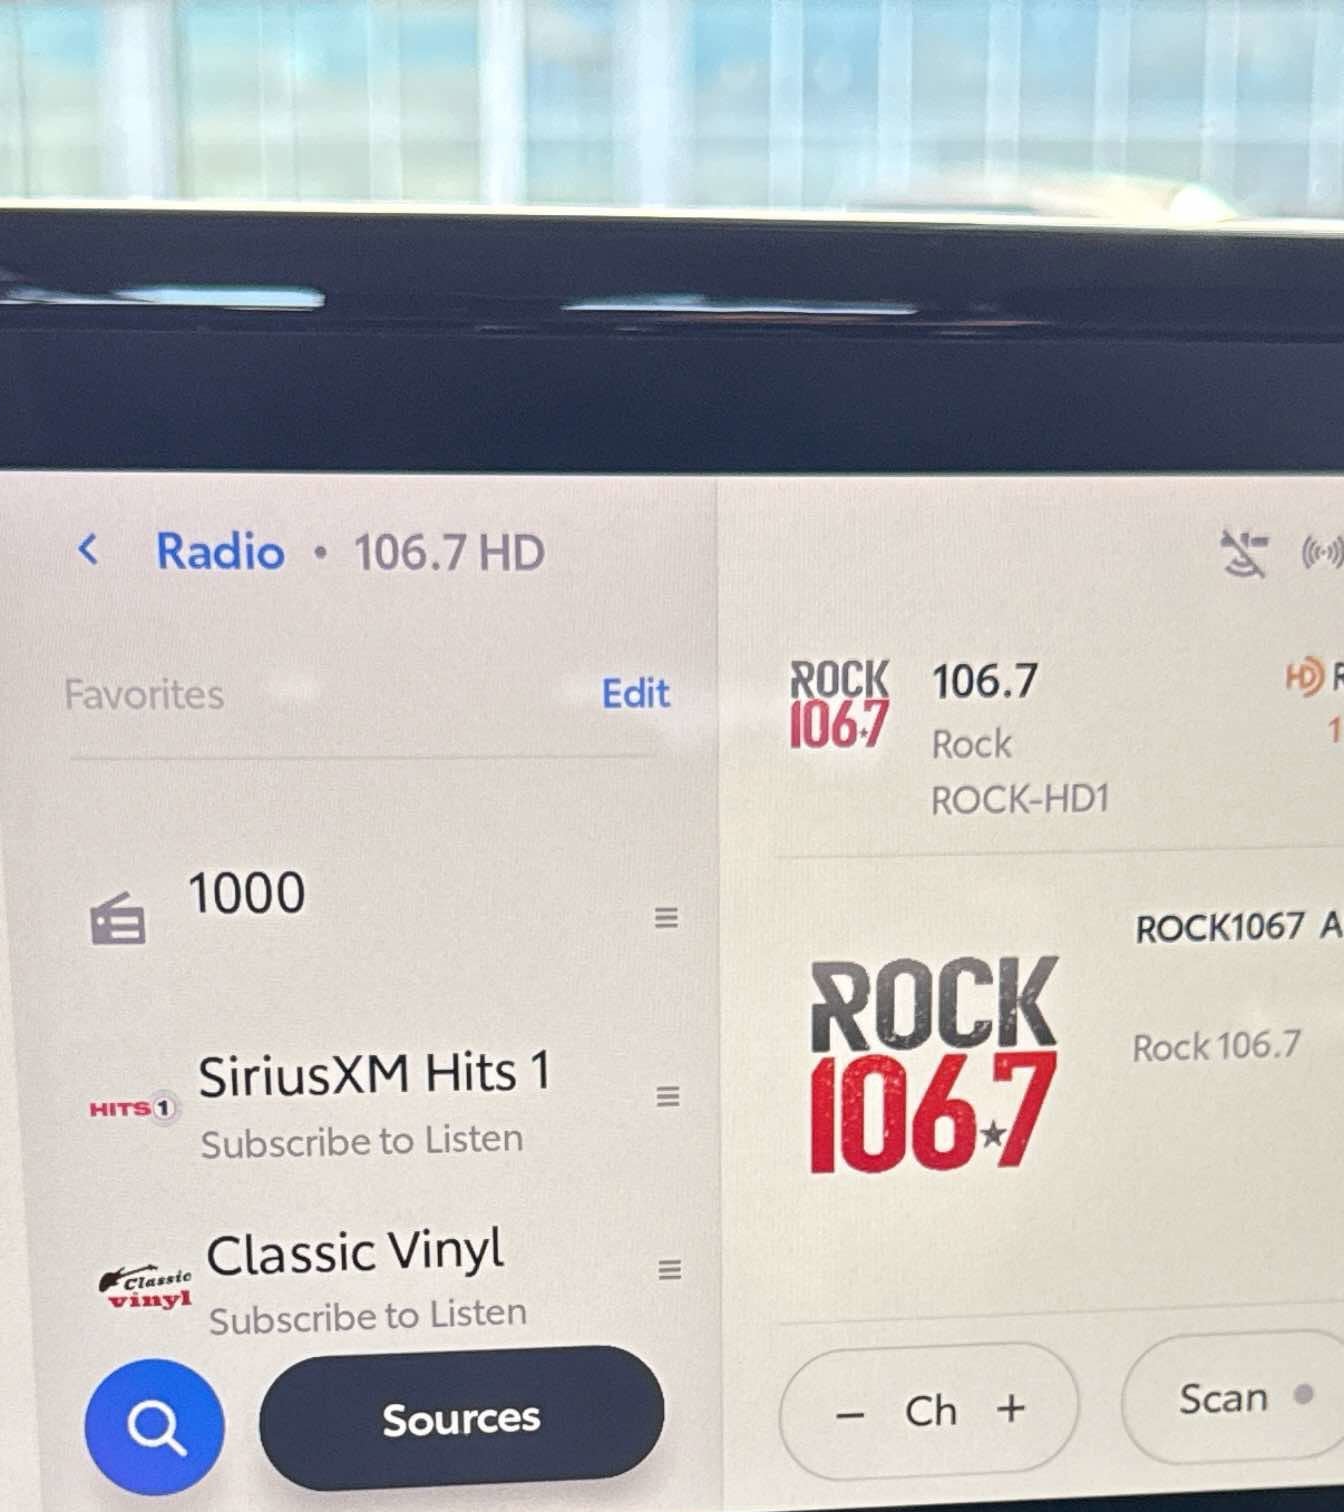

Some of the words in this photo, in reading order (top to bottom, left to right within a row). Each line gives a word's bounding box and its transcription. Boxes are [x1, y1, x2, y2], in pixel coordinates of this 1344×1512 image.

[157, 530, 285, 570] Radio
[355, 532, 468, 571] 106.7
[480, 532, 545, 571] HD
[64, 676, 225, 711] Favorites
[602, 676, 671, 709] Edit
[790, 658, 891, 698] ROCK
[933, 662, 1039, 699] 106.7
[932, 726, 1013, 759] Rock
[1328, 716, 1341, 744] 1
[932, 782, 1109, 816] ROCK-HD1
[189, 870, 305, 915] 1000
[1137, 910, 1306, 944] ROCK1067
[810, 954, 1060, 1053] ROCK
[1133, 1030, 1211, 1063] Rock
[1218, 1028, 1303, 1060] 106.7
[199, 1053, 408, 1099] SiriusXM
[427, 1049, 517, 1092] Hits
[531, 1049, 547, 1089] 1
[89, 1100, 153, 1117] HITS
[201, 1126, 371, 1160] Subscribe
[378, 1127, 415, 1156] to
[426, 1123, 524, 1154] Listen
[207, 1230, 376, 1277] Classic
[387, 1225, 505, 1278] Vinyl
[123, 1269, 193, 1291] Classic
[108, 1289, 193, 1311] vinyl
[209, 1301, 377, 1337] Subscribe
[384, 1302, 420, 1330] to
[430, 1297, 527, 1329] Listen
[905, 1393, 957, 1427] Ch
[1180, 1382, 1268, 1415] Scan
[383, 1403, 541, 1438] Sources
